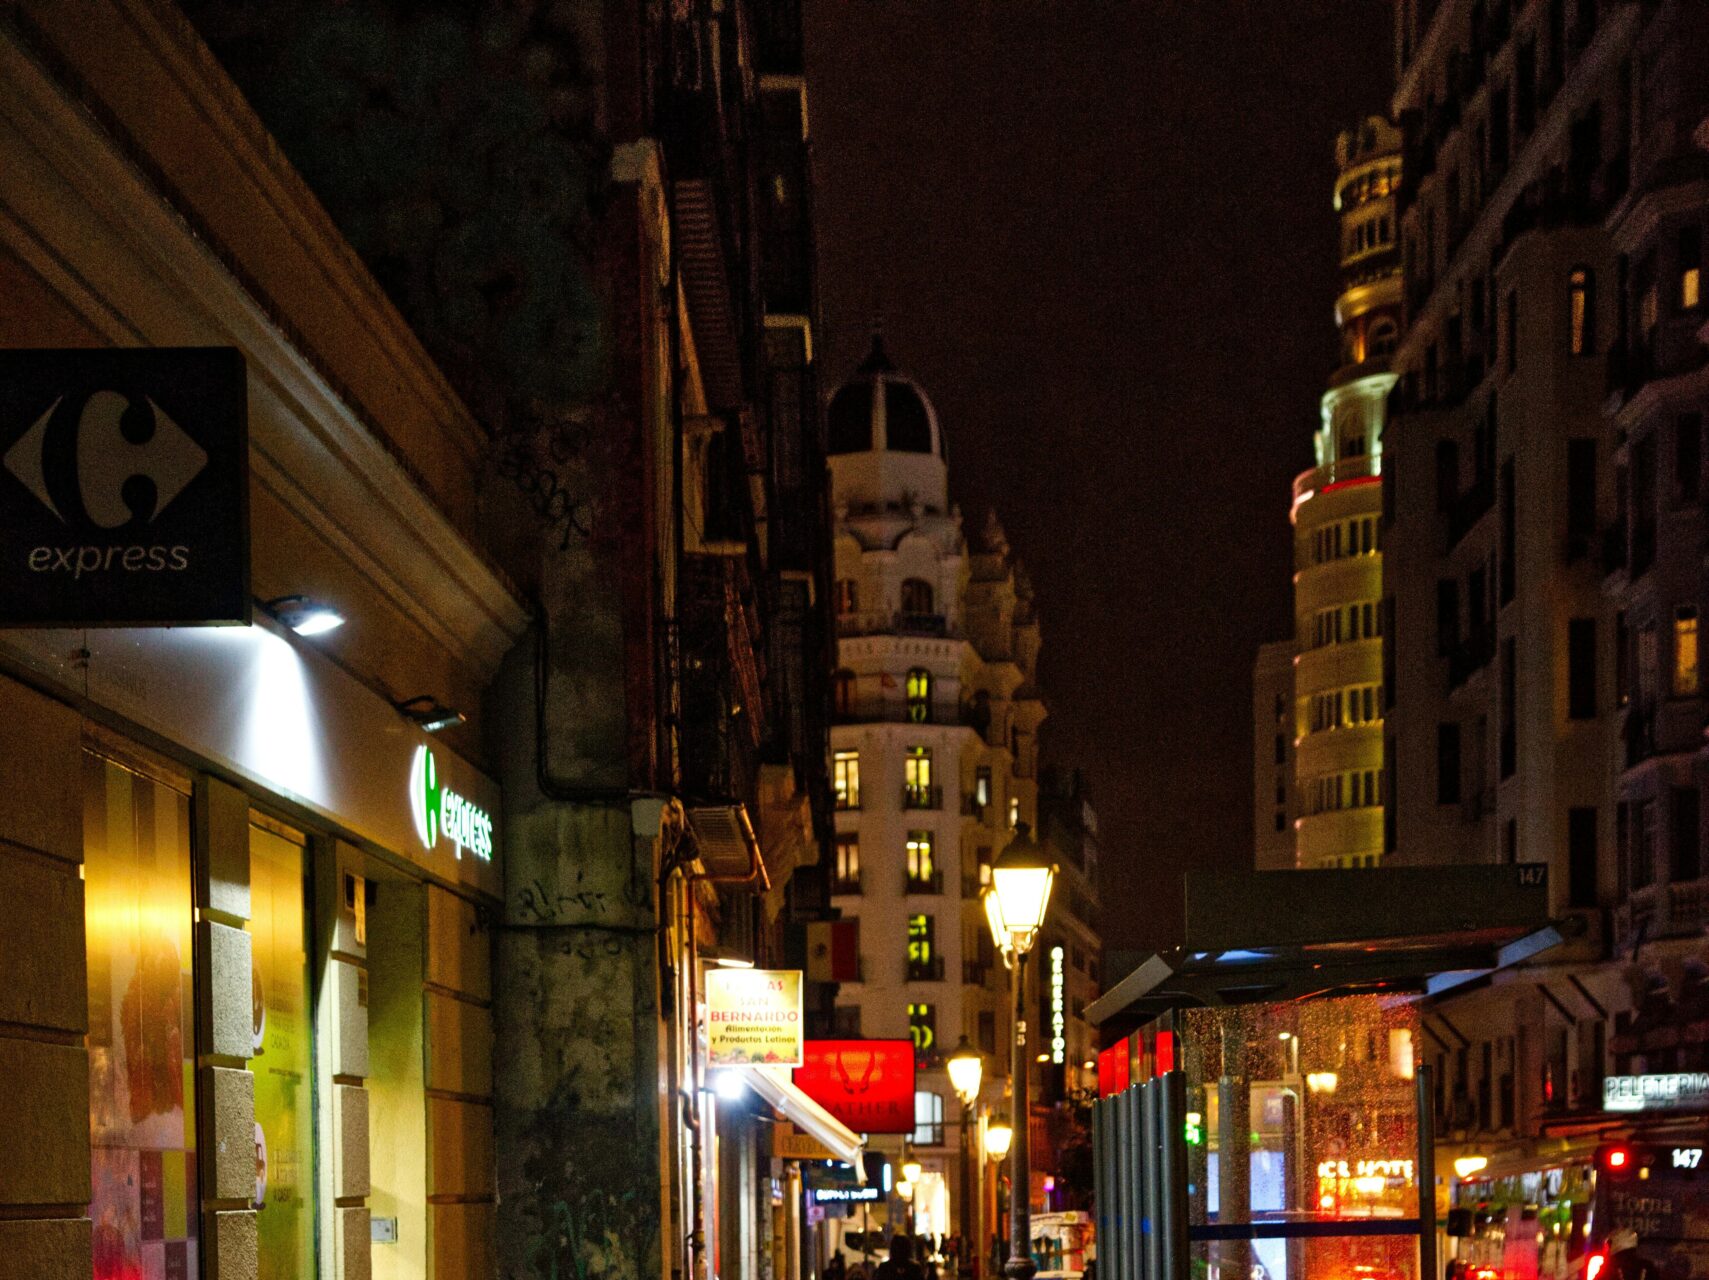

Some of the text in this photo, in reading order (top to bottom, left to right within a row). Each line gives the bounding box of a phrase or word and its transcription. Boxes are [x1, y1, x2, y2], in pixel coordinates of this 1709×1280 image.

[28, 545, 190, 580] express
[441, 786, 493, 861] express
[1519, 867, 1545, 885] 147
[1051, 946, 1065, 1064] GENERATOR
[711, 1010, 799, 1022] BERNARDO
[711, 1034, 796, 1044] y Productos Latinos
[1672, 1148, 1703, 1169] 147
